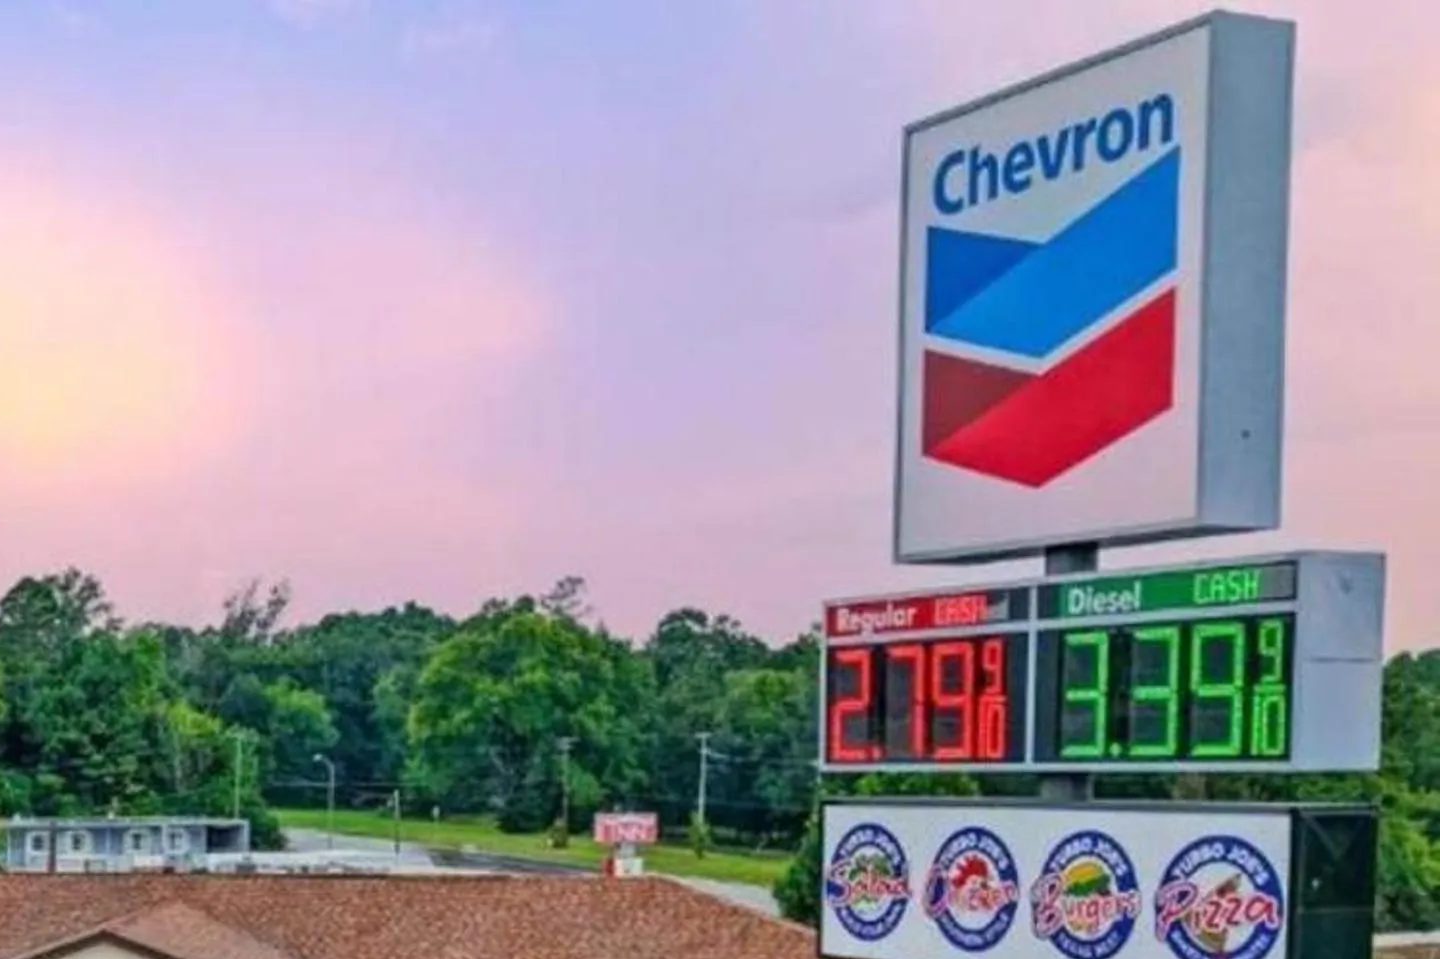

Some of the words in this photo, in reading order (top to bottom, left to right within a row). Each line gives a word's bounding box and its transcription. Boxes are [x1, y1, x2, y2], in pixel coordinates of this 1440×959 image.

[933, 92, 1175, 216] Chevron
[836, 602, 917, 636] Regular
[933, 595, 989, 626] CASH
[1067, 581, 1142, 614] Diesel
[1194, 569, 1261, 604] CASH
[1155, 879, 1281, 943] Pizza
